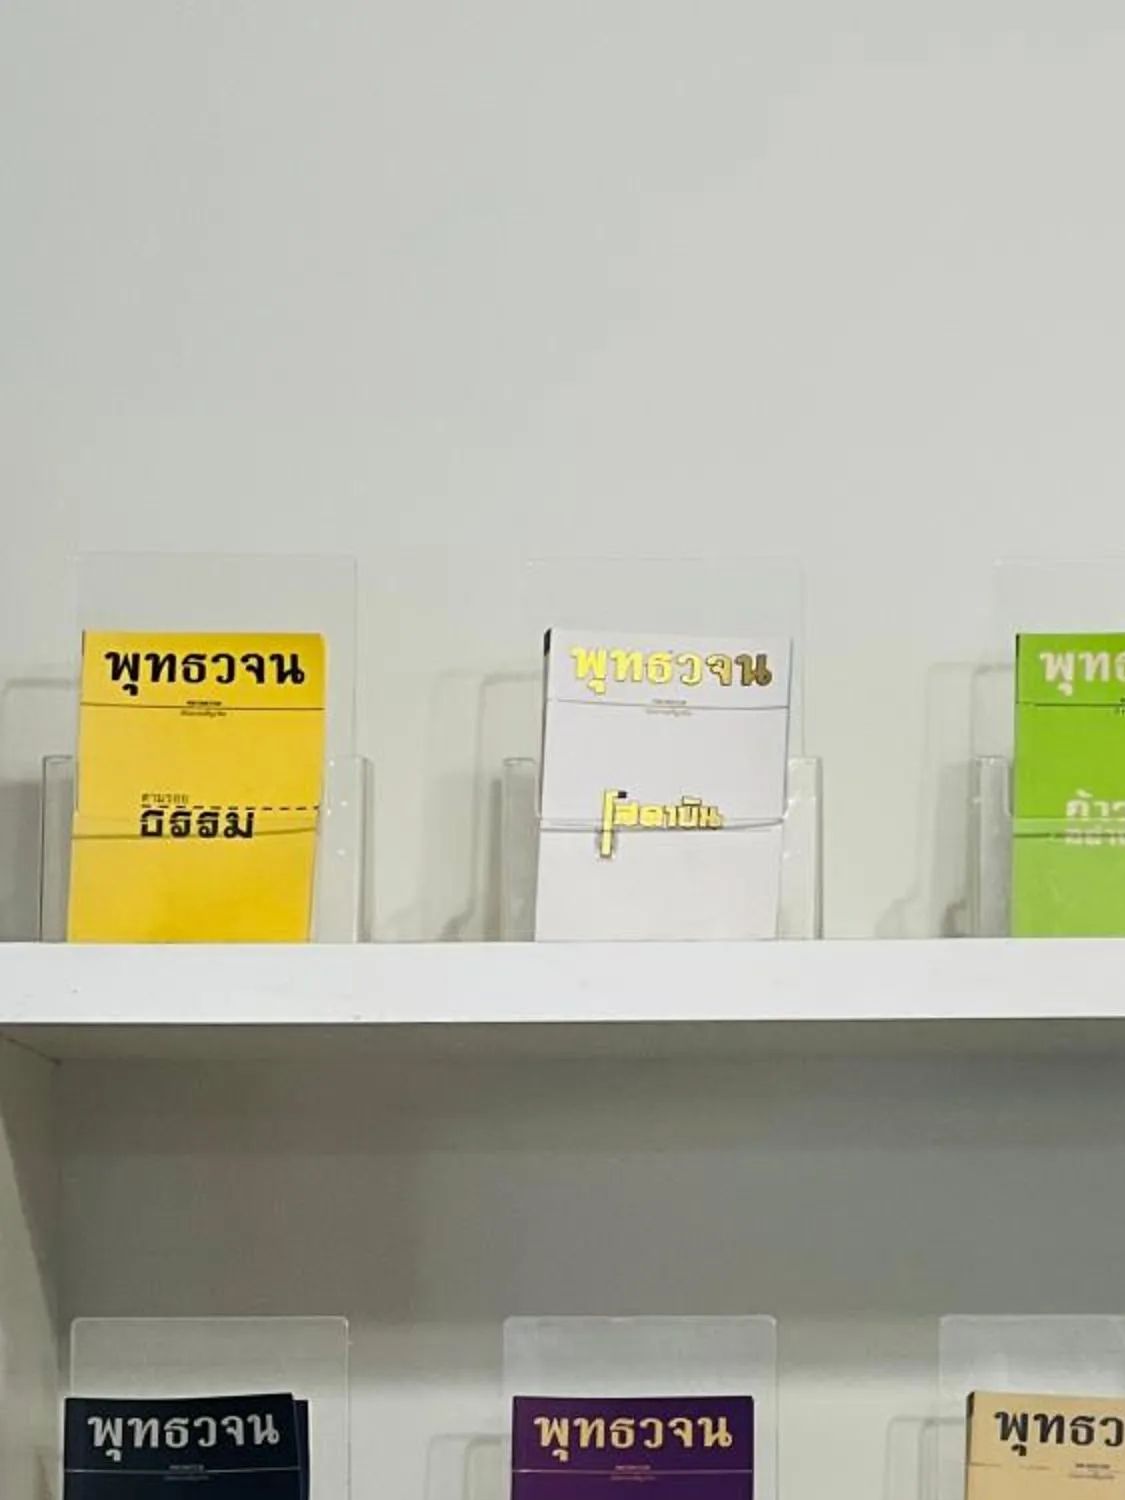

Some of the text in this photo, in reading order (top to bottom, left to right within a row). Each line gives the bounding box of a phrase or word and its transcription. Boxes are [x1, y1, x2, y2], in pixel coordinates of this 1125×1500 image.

[104, 650, 305, 696] พุทธวจน
[570, 646, 772, 695] พุทธวจน
[139, 809, 255, 839] ธรรม
[87, 1413, 280, 1462] พุทธวจน
[534, 1415, 733, 1461] พุทธวจน
